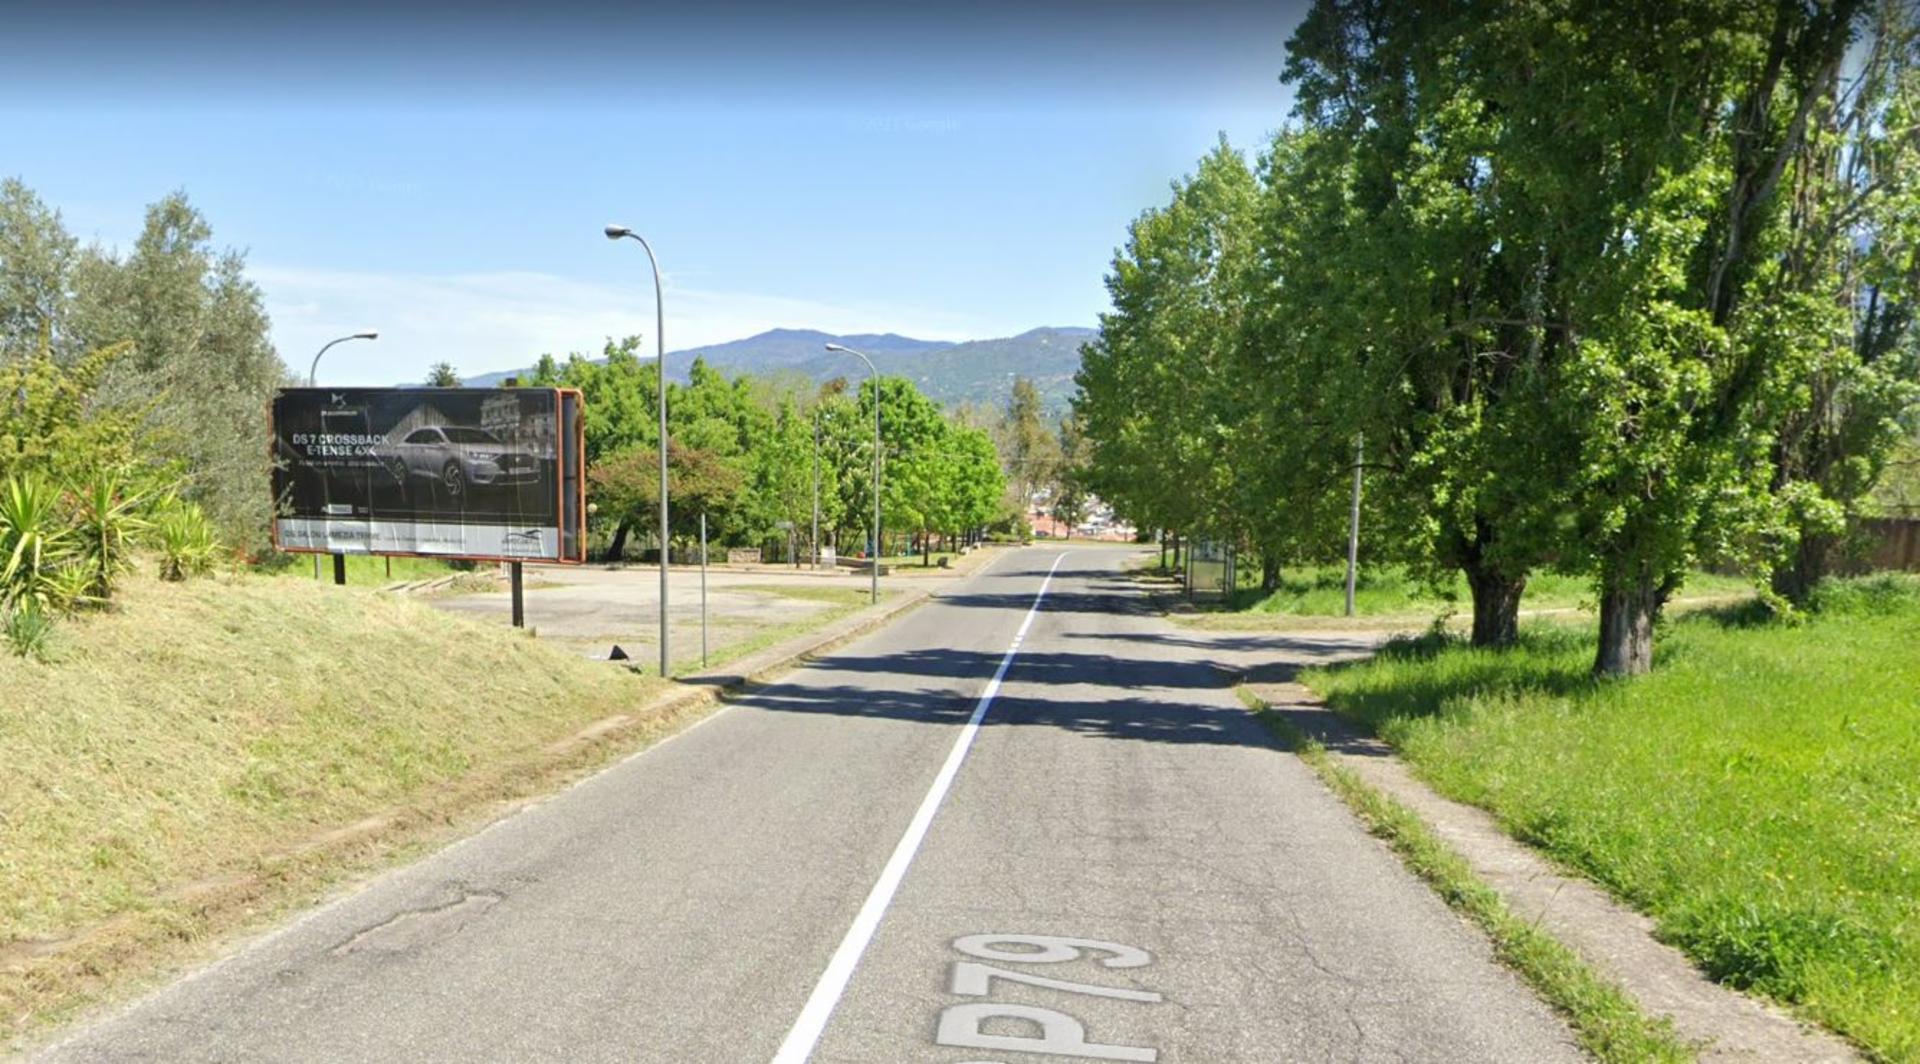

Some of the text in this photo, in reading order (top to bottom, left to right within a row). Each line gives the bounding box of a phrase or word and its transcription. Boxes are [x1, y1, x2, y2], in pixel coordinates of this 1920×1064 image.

[292, 434, 390, 446] DS 7 CROSSBACK
